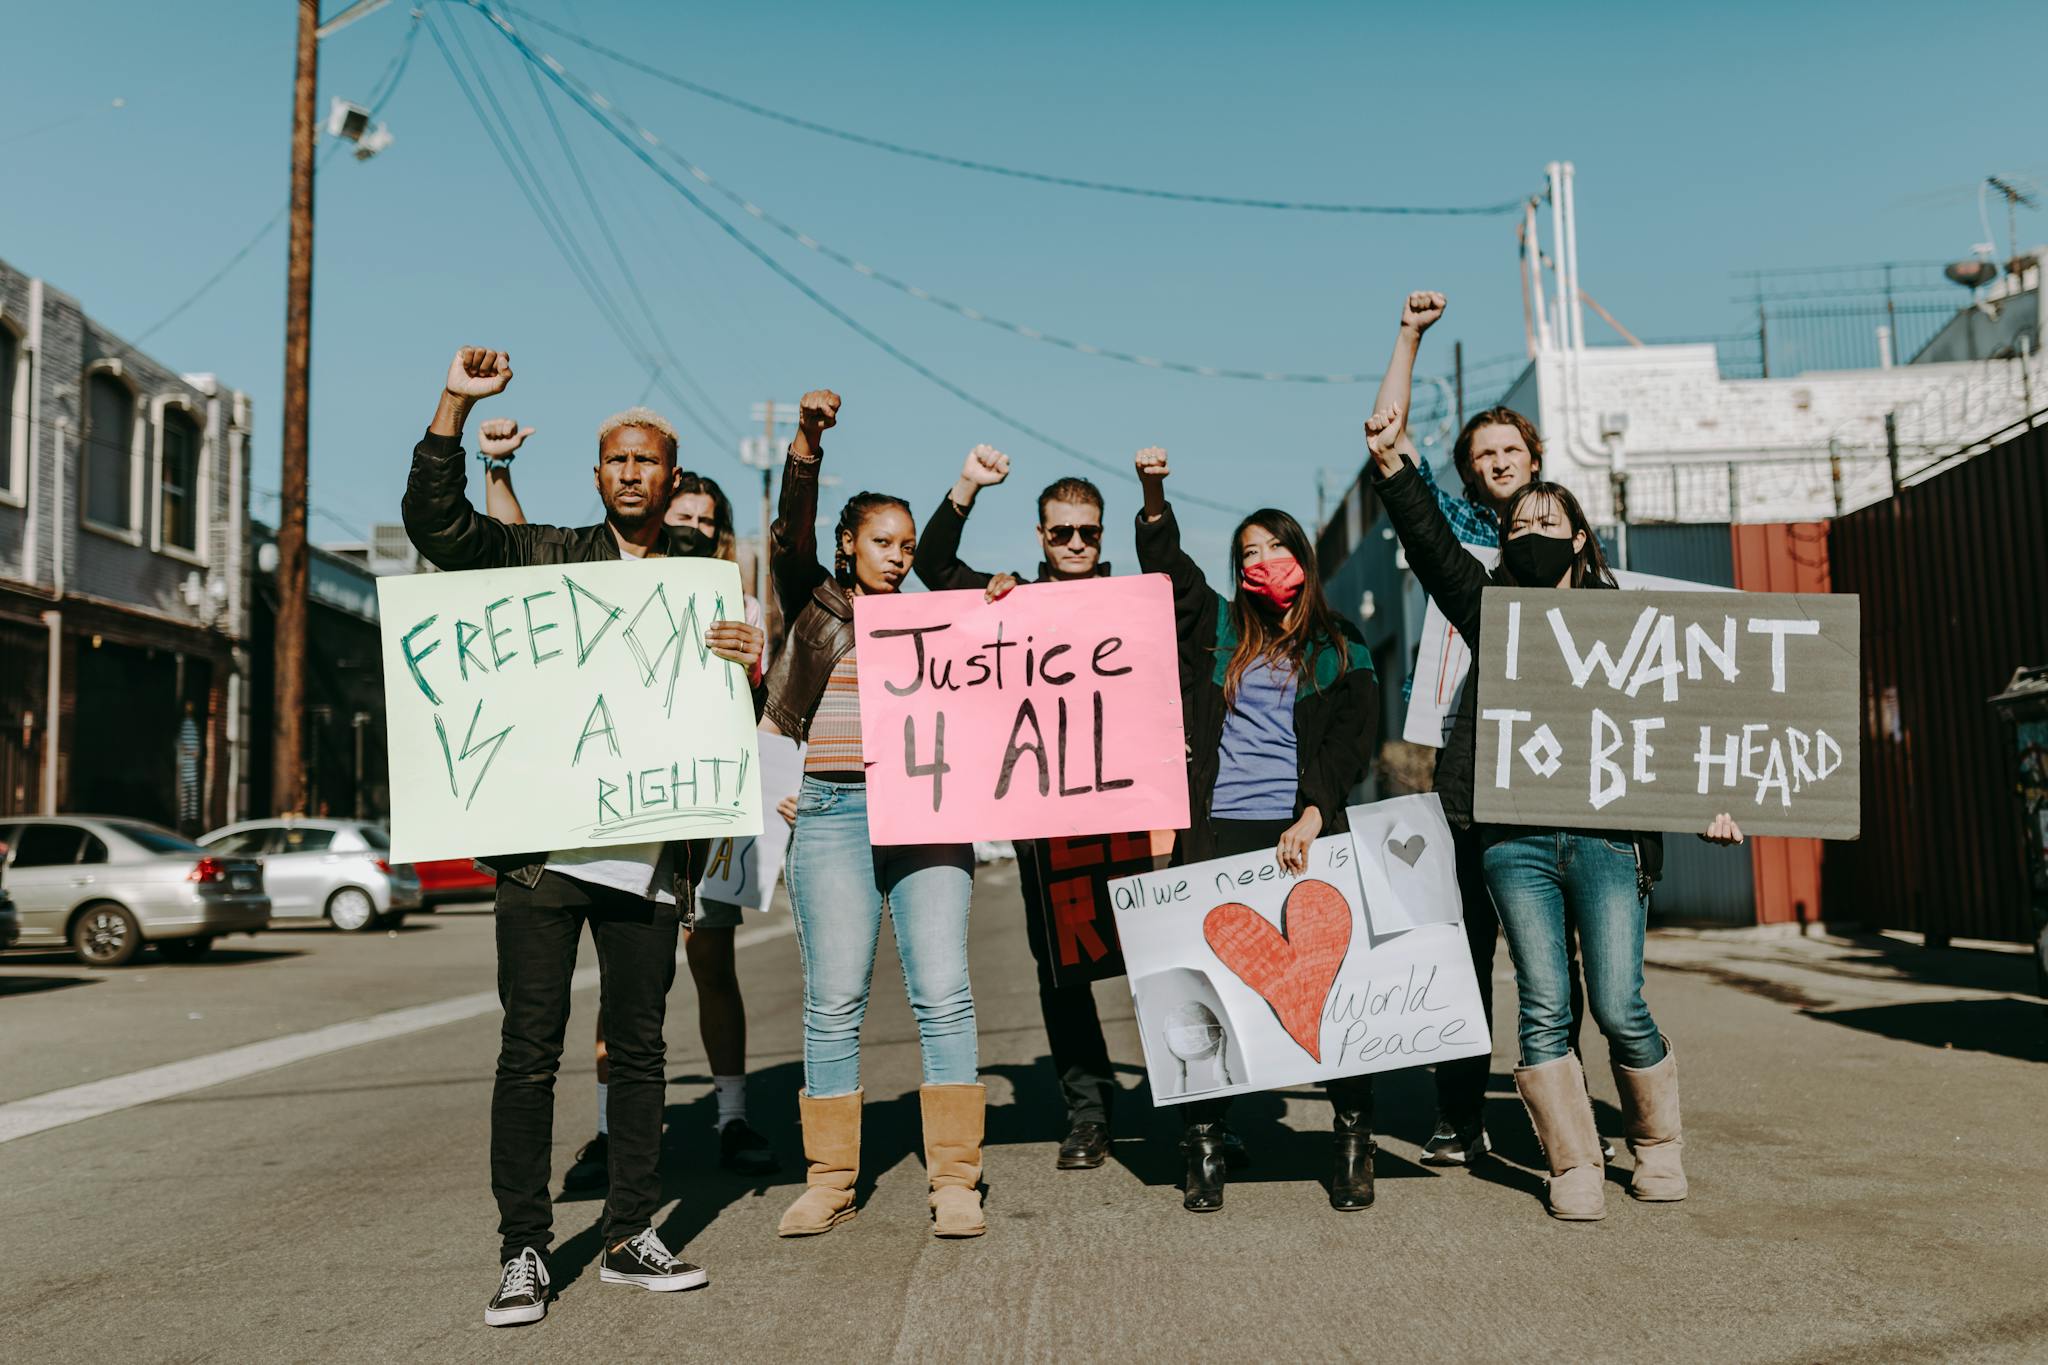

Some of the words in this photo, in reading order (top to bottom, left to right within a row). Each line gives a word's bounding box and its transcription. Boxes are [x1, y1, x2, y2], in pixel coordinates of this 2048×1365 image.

[400, 574, 734, 719] FREEDOM
[869, 621, 1133, 697] Justice
[1505, 601, 1521, 681] I
[1546, 605, 1820, 702] WANT
[434, 699, 515, 811] IS
[571, 693, 622, 767] A
[598, 747, 750, 826] RIGHT!
[904, 711, 951, 813] 4
[994, 690, 1134, 800] ALL
[1482, 708, 1563, 790] TO
[1589, 707, 1666, 810] BE
[1694, 723, 1842, 808] HEARD
[1115, 877, 1146, 911] all
[1152, 879, 1192, 905] we
[1328, 845, 1349, 869] is
[1325, 964, 1451, 1023] World
[1337, 1019, 1479, 1067] Peace
